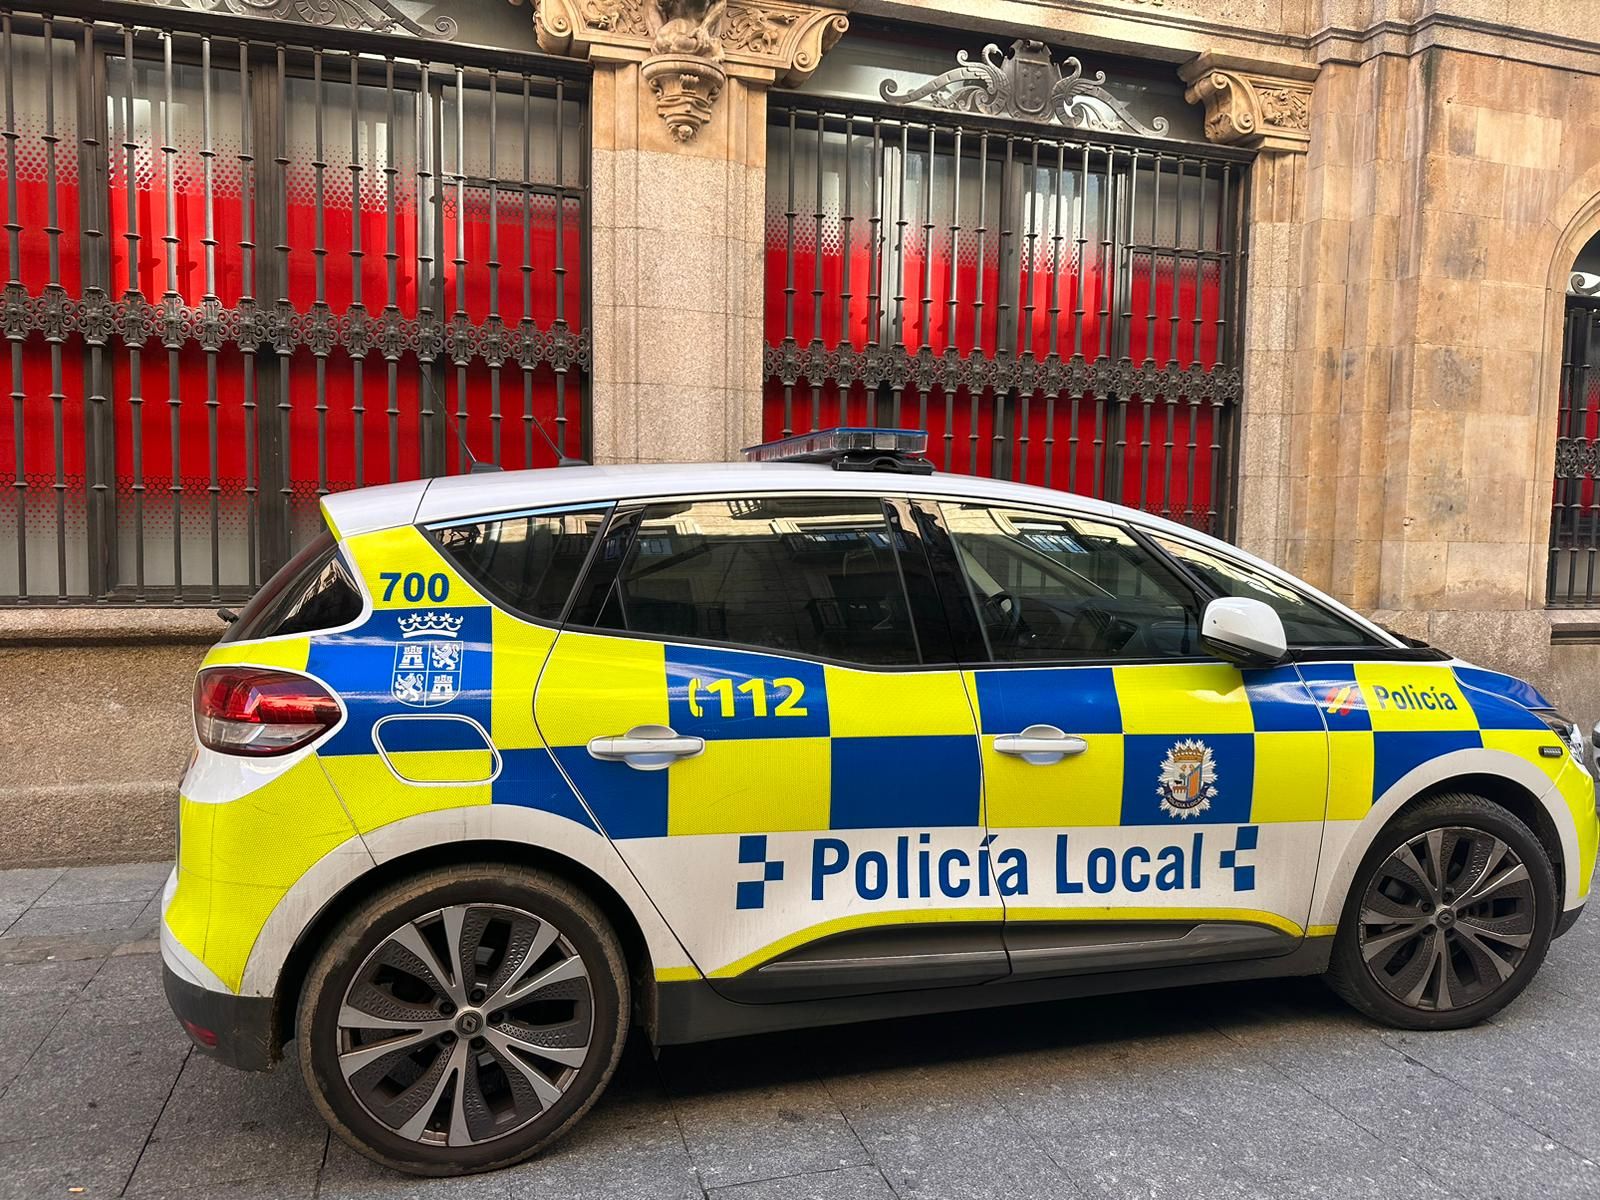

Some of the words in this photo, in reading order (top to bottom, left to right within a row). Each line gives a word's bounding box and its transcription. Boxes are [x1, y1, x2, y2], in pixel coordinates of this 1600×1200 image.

[380, 572, 449, 602] 700
[705, 677, 808, 717] 112
[1372, 684, 1458, 710] Policía
[811, 833, 1028, 900] Policía
[1056, 832, 1203, 893] Local
